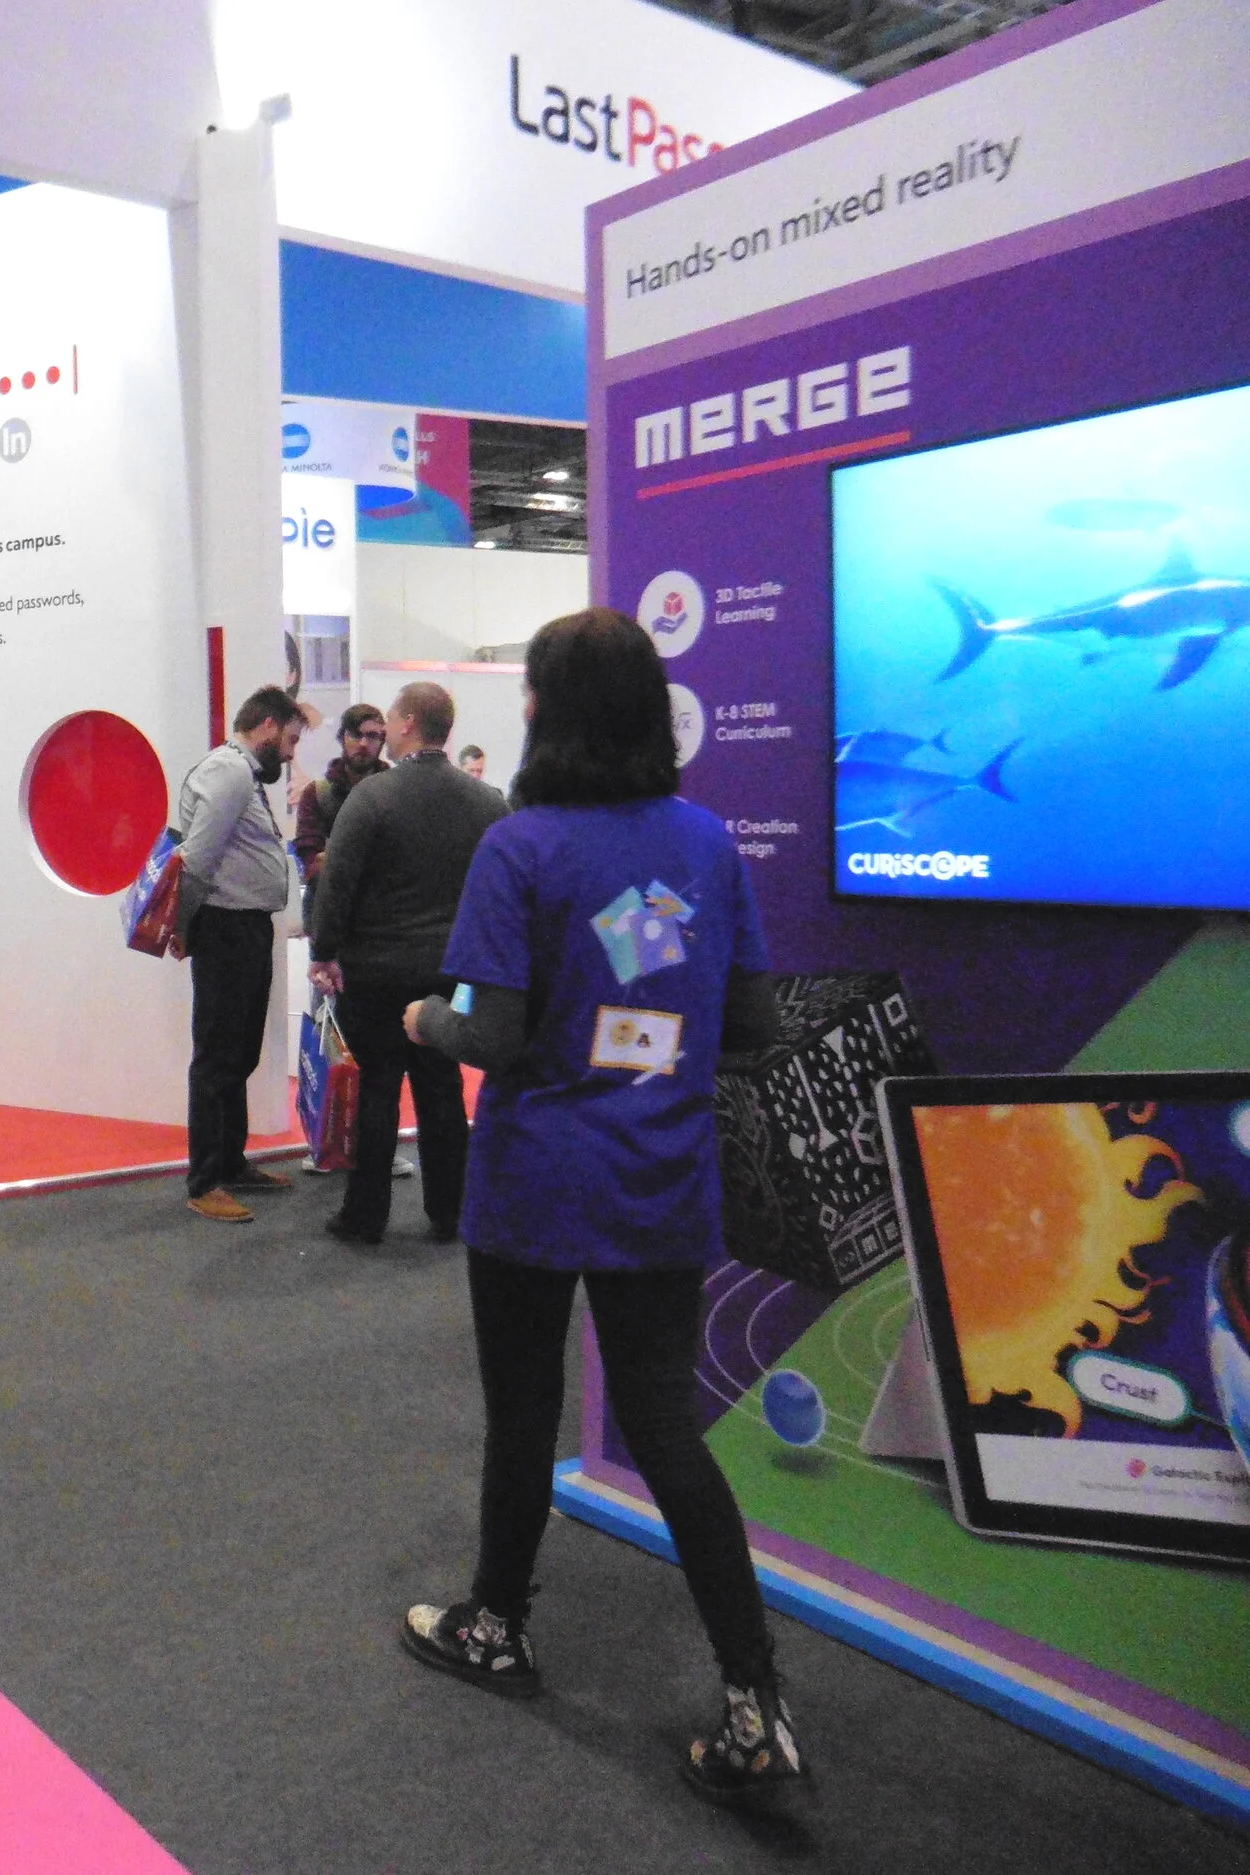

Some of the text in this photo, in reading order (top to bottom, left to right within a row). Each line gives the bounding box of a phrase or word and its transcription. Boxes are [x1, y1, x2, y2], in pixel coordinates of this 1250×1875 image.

[510, 54, 725, 175] LastPas
[626, 135, 1022, 298] Hands-on mixed reality
[6, 534, 66, 552] campus.
[17, 589, 84, 615] passwords,
[716, 582, 783, 603] 3D Tactile
[716, 605, 777, 625] Learning
[716, 702, 776, 720] K-8 STEM
[716, 725, 792, 741] Curriculum
[737, 818, 798, 834] Creation
[737, 841, 776, 859] esign
[1101, 1373, 1158, 1401] Crust
